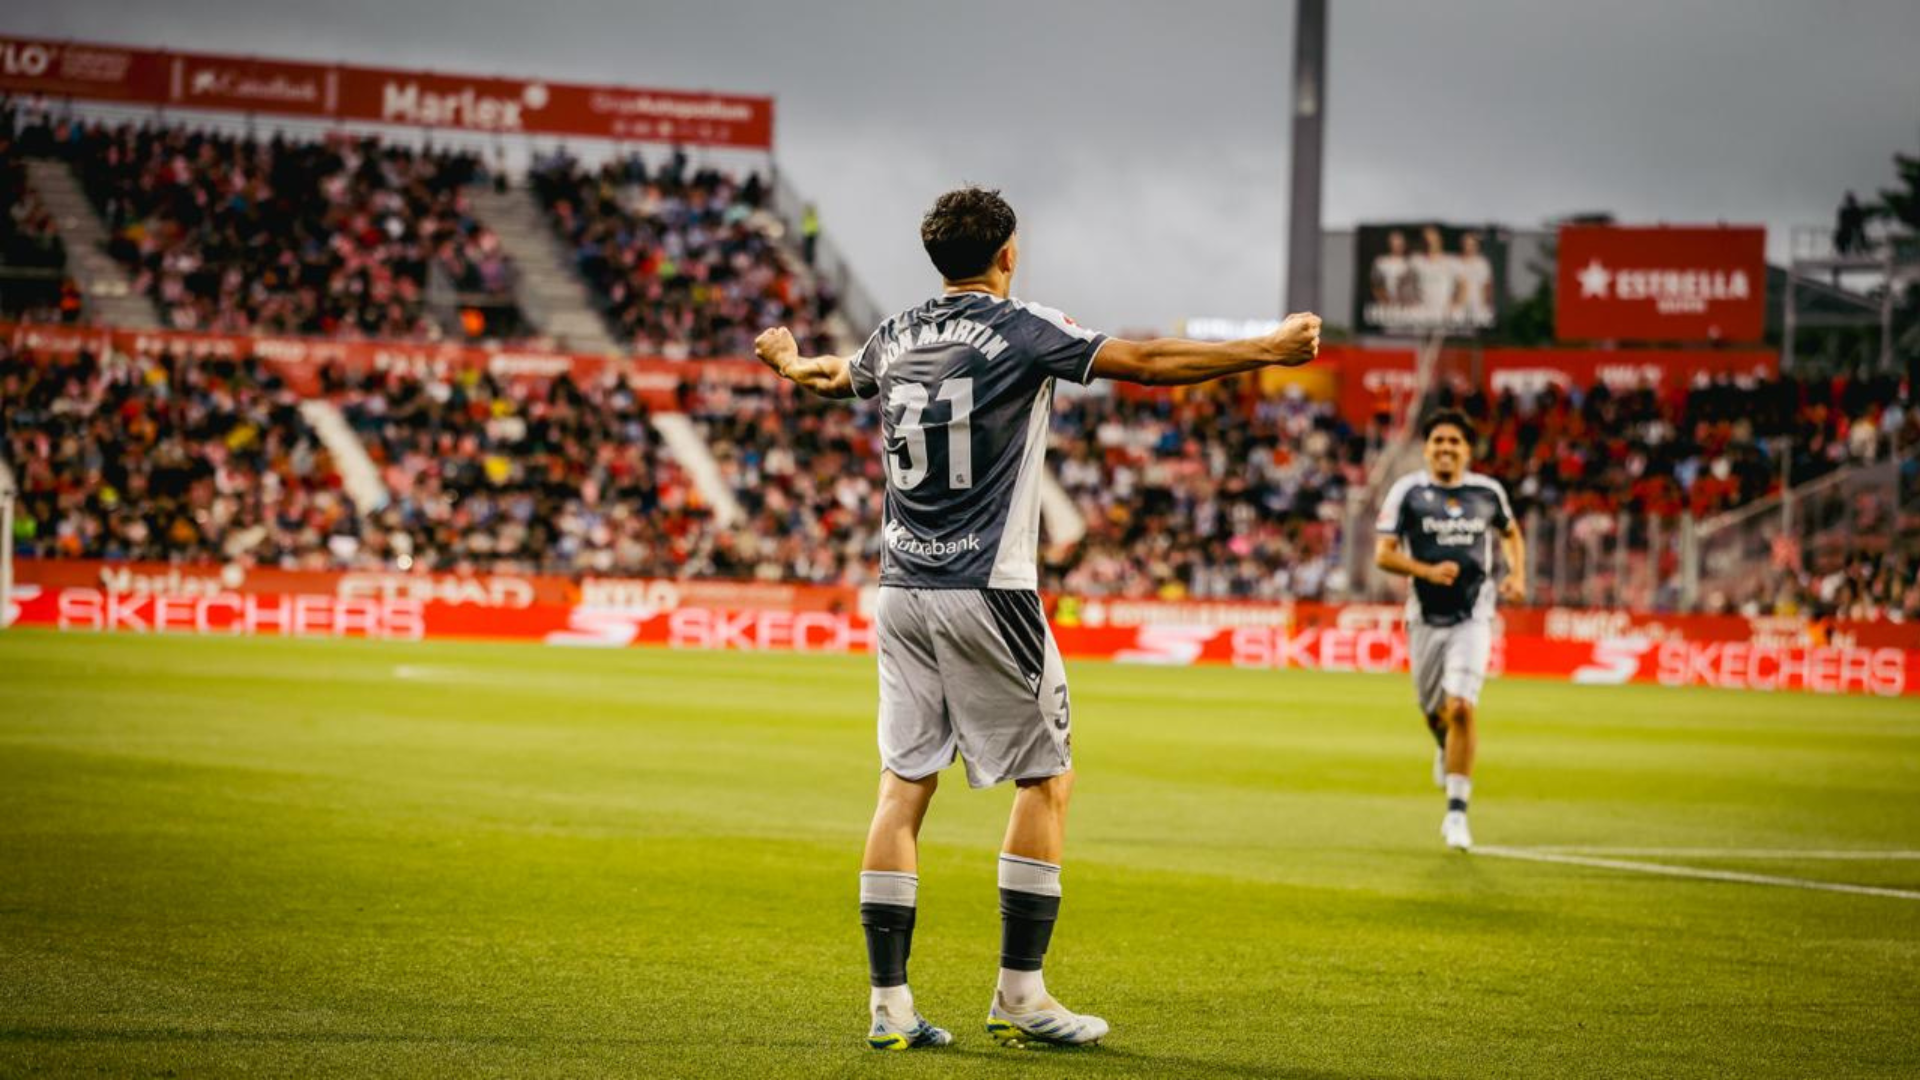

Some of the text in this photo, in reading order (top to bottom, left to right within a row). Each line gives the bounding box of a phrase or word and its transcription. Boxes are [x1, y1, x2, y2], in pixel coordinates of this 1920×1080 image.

[382, 82, 524, 129] Marlex
[1614, 269, 1749, 299] ESTRELLA
[889, 377, 974, 491] 31
[58, 587, 425, 640] SKECHERS
[668, 607, 877, 650] SKECH
[1657, 641, 1906, 696] SKECHERS
